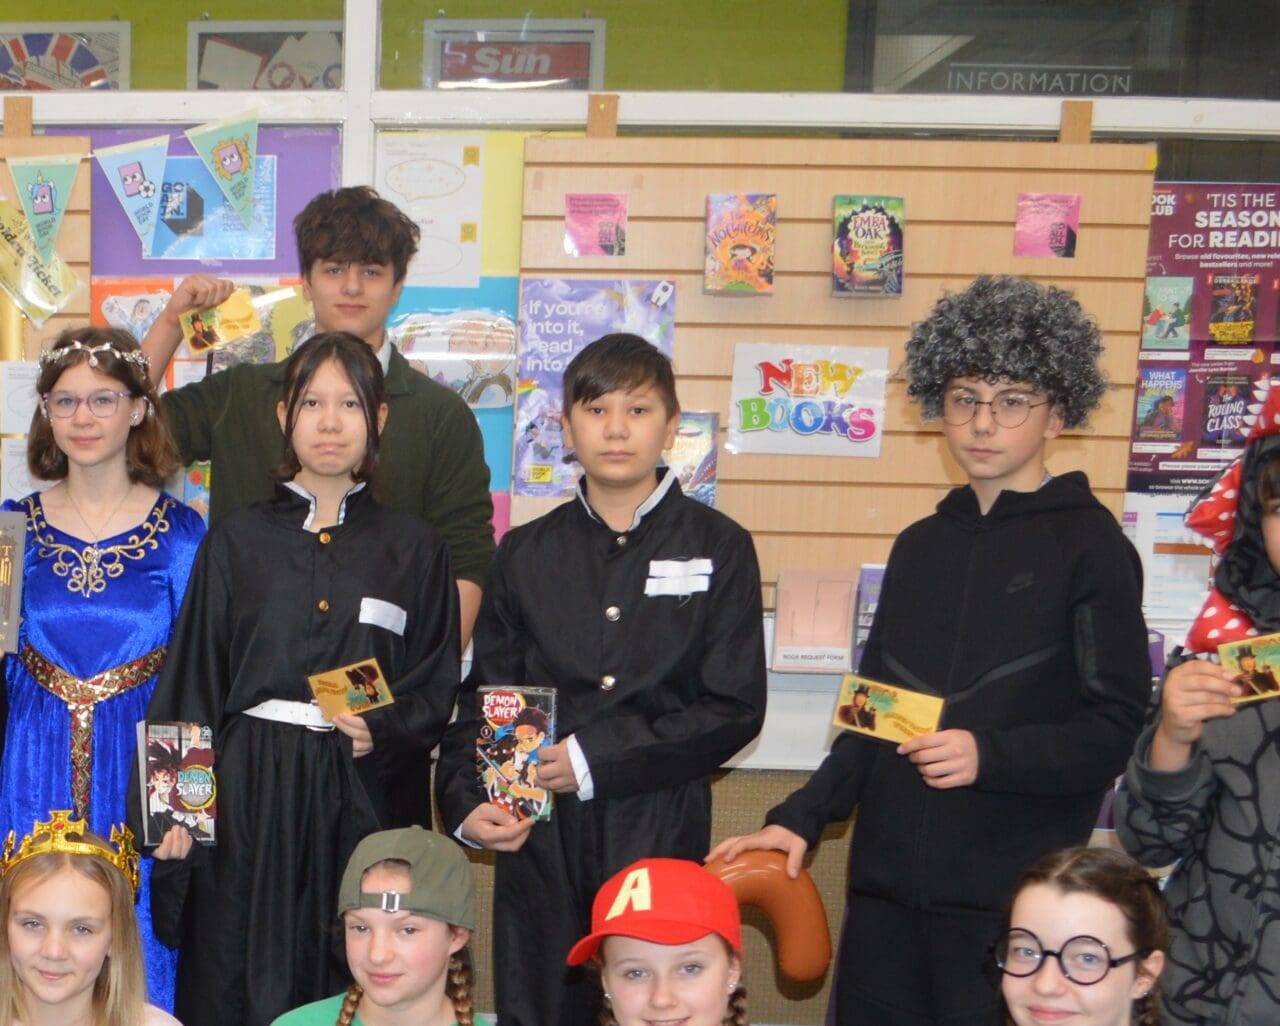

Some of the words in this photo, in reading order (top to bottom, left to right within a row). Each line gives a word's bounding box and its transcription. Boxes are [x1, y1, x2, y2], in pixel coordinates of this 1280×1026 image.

[472, 48, 551, 74] Sun
[947, 72, 1131, 93] INFORMATION
[1207, 193, 1237, 207] 'TIS
[1242, 193, 1276, 207] THE
[853, 216, 886, 230] EMBA
[1195, 211, 1280, 228] SEASON
[855, 227, 883, 240] OAK
[1168, 234, 1205, 248] FOR
[1209, 231, 1280, 248] READI
[529, 300, 541, 315] If
[756, 358, 863, 397] NEW
[1149, 371, 1176, 380] WHAT
[1141, 380, 1182, 389] HAPPENS
[1208, 400, 1246, 418] RULING
[737, 397, 877, 442] BOOKS
[1207, 415, 1242, 432] CLASS
[484, 694, 518, 707] DEMON
[482, 705, 519, 719] SLAYER
[178, 770, 212, 782] DEMON
[176, 783, 213, 796] SLAYER
[605, 866, 653, 921] A
